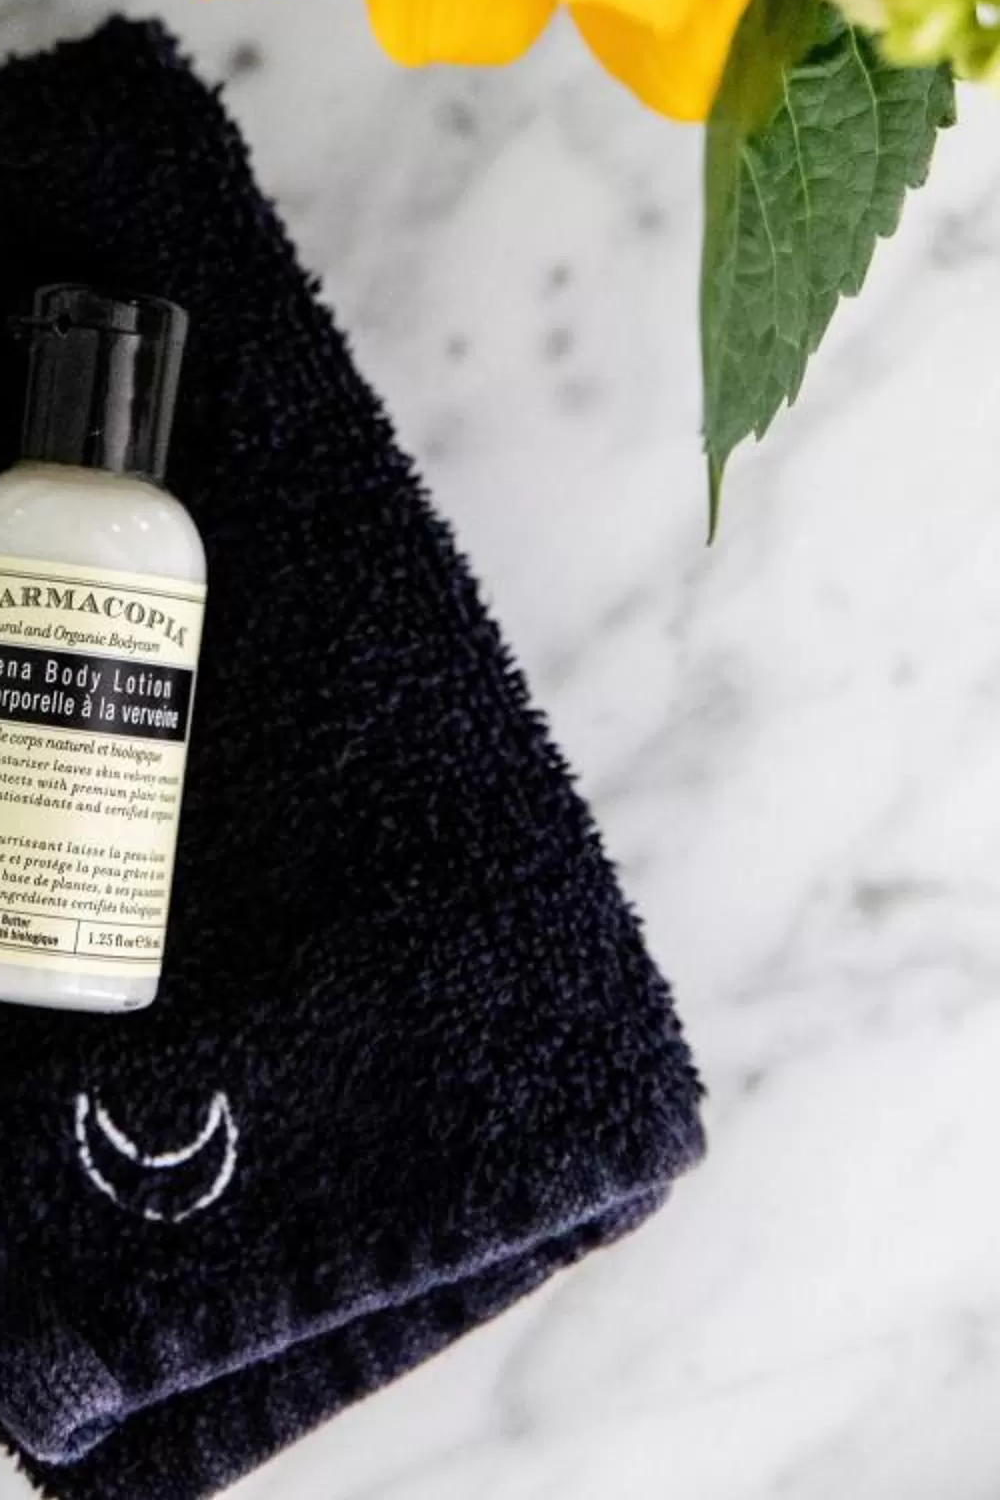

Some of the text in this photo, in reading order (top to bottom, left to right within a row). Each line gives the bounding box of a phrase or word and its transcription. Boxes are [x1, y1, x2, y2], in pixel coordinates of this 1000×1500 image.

[23, 623, 51, 638] and
[53, 625, 106, 646] Organic
[45, 660, 101, 693] Body
[114, 669, 172, 698] Lotion
[81, 694, 92, 718] à
[99, 697, 116, 721] la
[122, 703, 179, 729] verveine
[9, 733, 43, 750] corps
[45, 738, 95, 754] naturel
[97, 744, 109, 756] et
[53, 760, 92, 776] leaves
[95, 765, 120, 779] skin
[37, 778, 67, 790] with
[70, 783, 127, 797] premium
[75, 800, 102, 813] and
[66, 841, 105, 857] laisse
[109, 844, 121, 859] la
[9, 853, 21, 865] et
[76, 860, 89, 873] la
[2, 868, 30, 884] base
[34, 874, 48, 887] de
